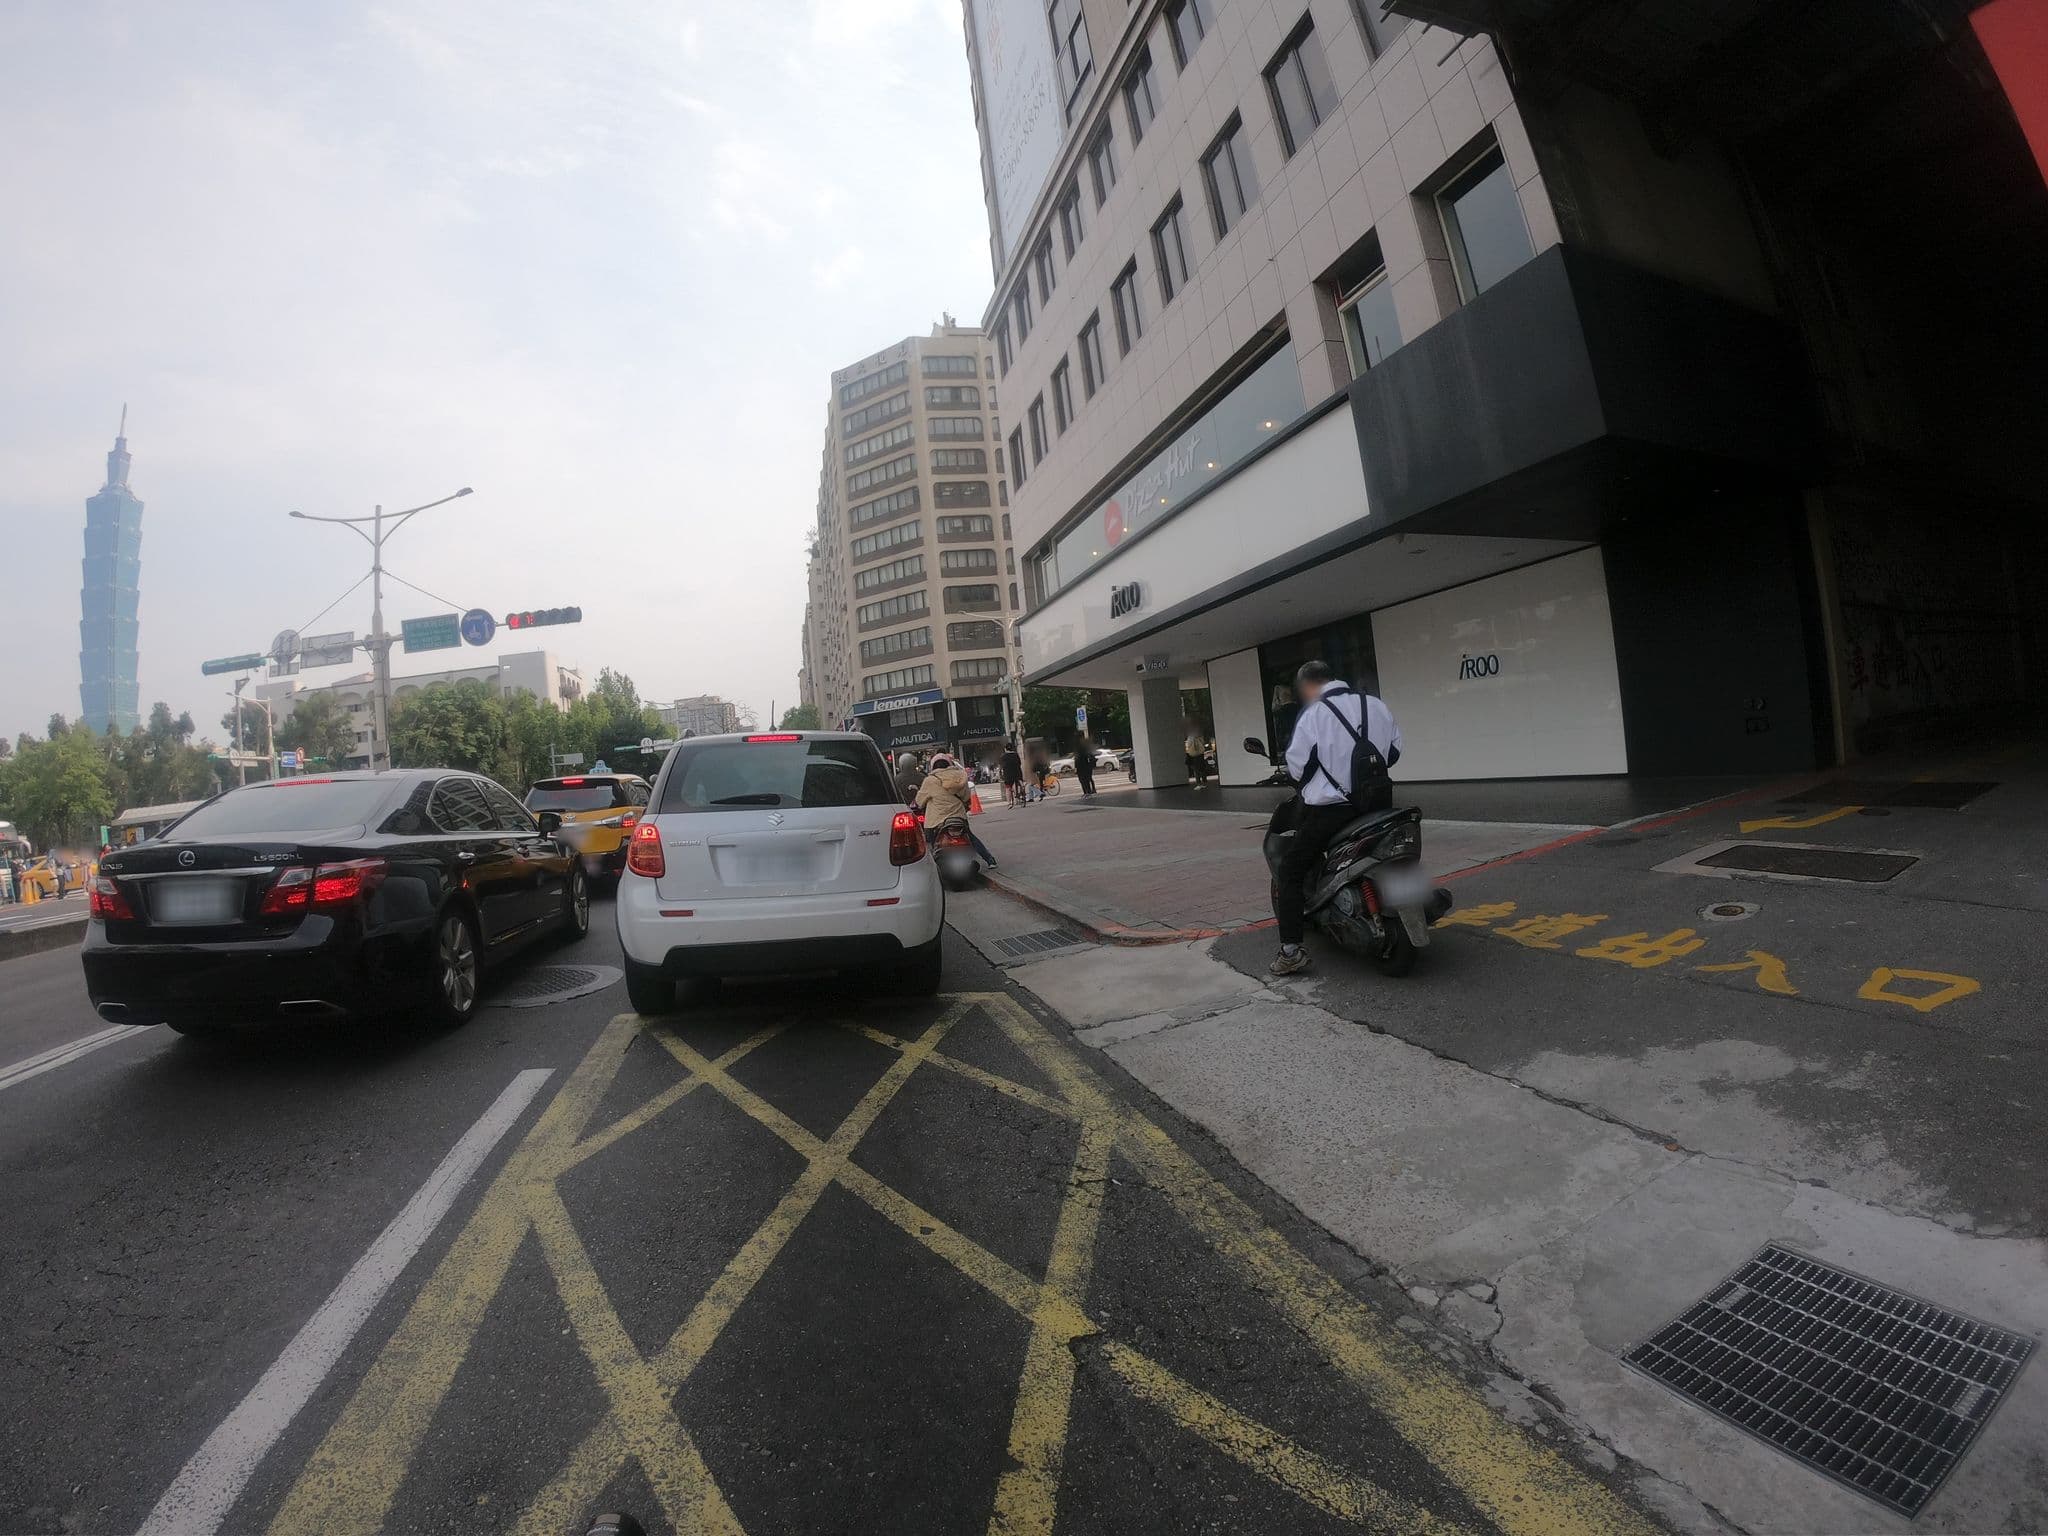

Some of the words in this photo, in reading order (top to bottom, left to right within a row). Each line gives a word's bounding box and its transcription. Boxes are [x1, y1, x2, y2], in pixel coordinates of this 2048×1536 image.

[873, 697, 919, 711] lenovo
[966, 727, 1001, 736] NAUTICA
[894, 732, 933, 745] NAUTICA
